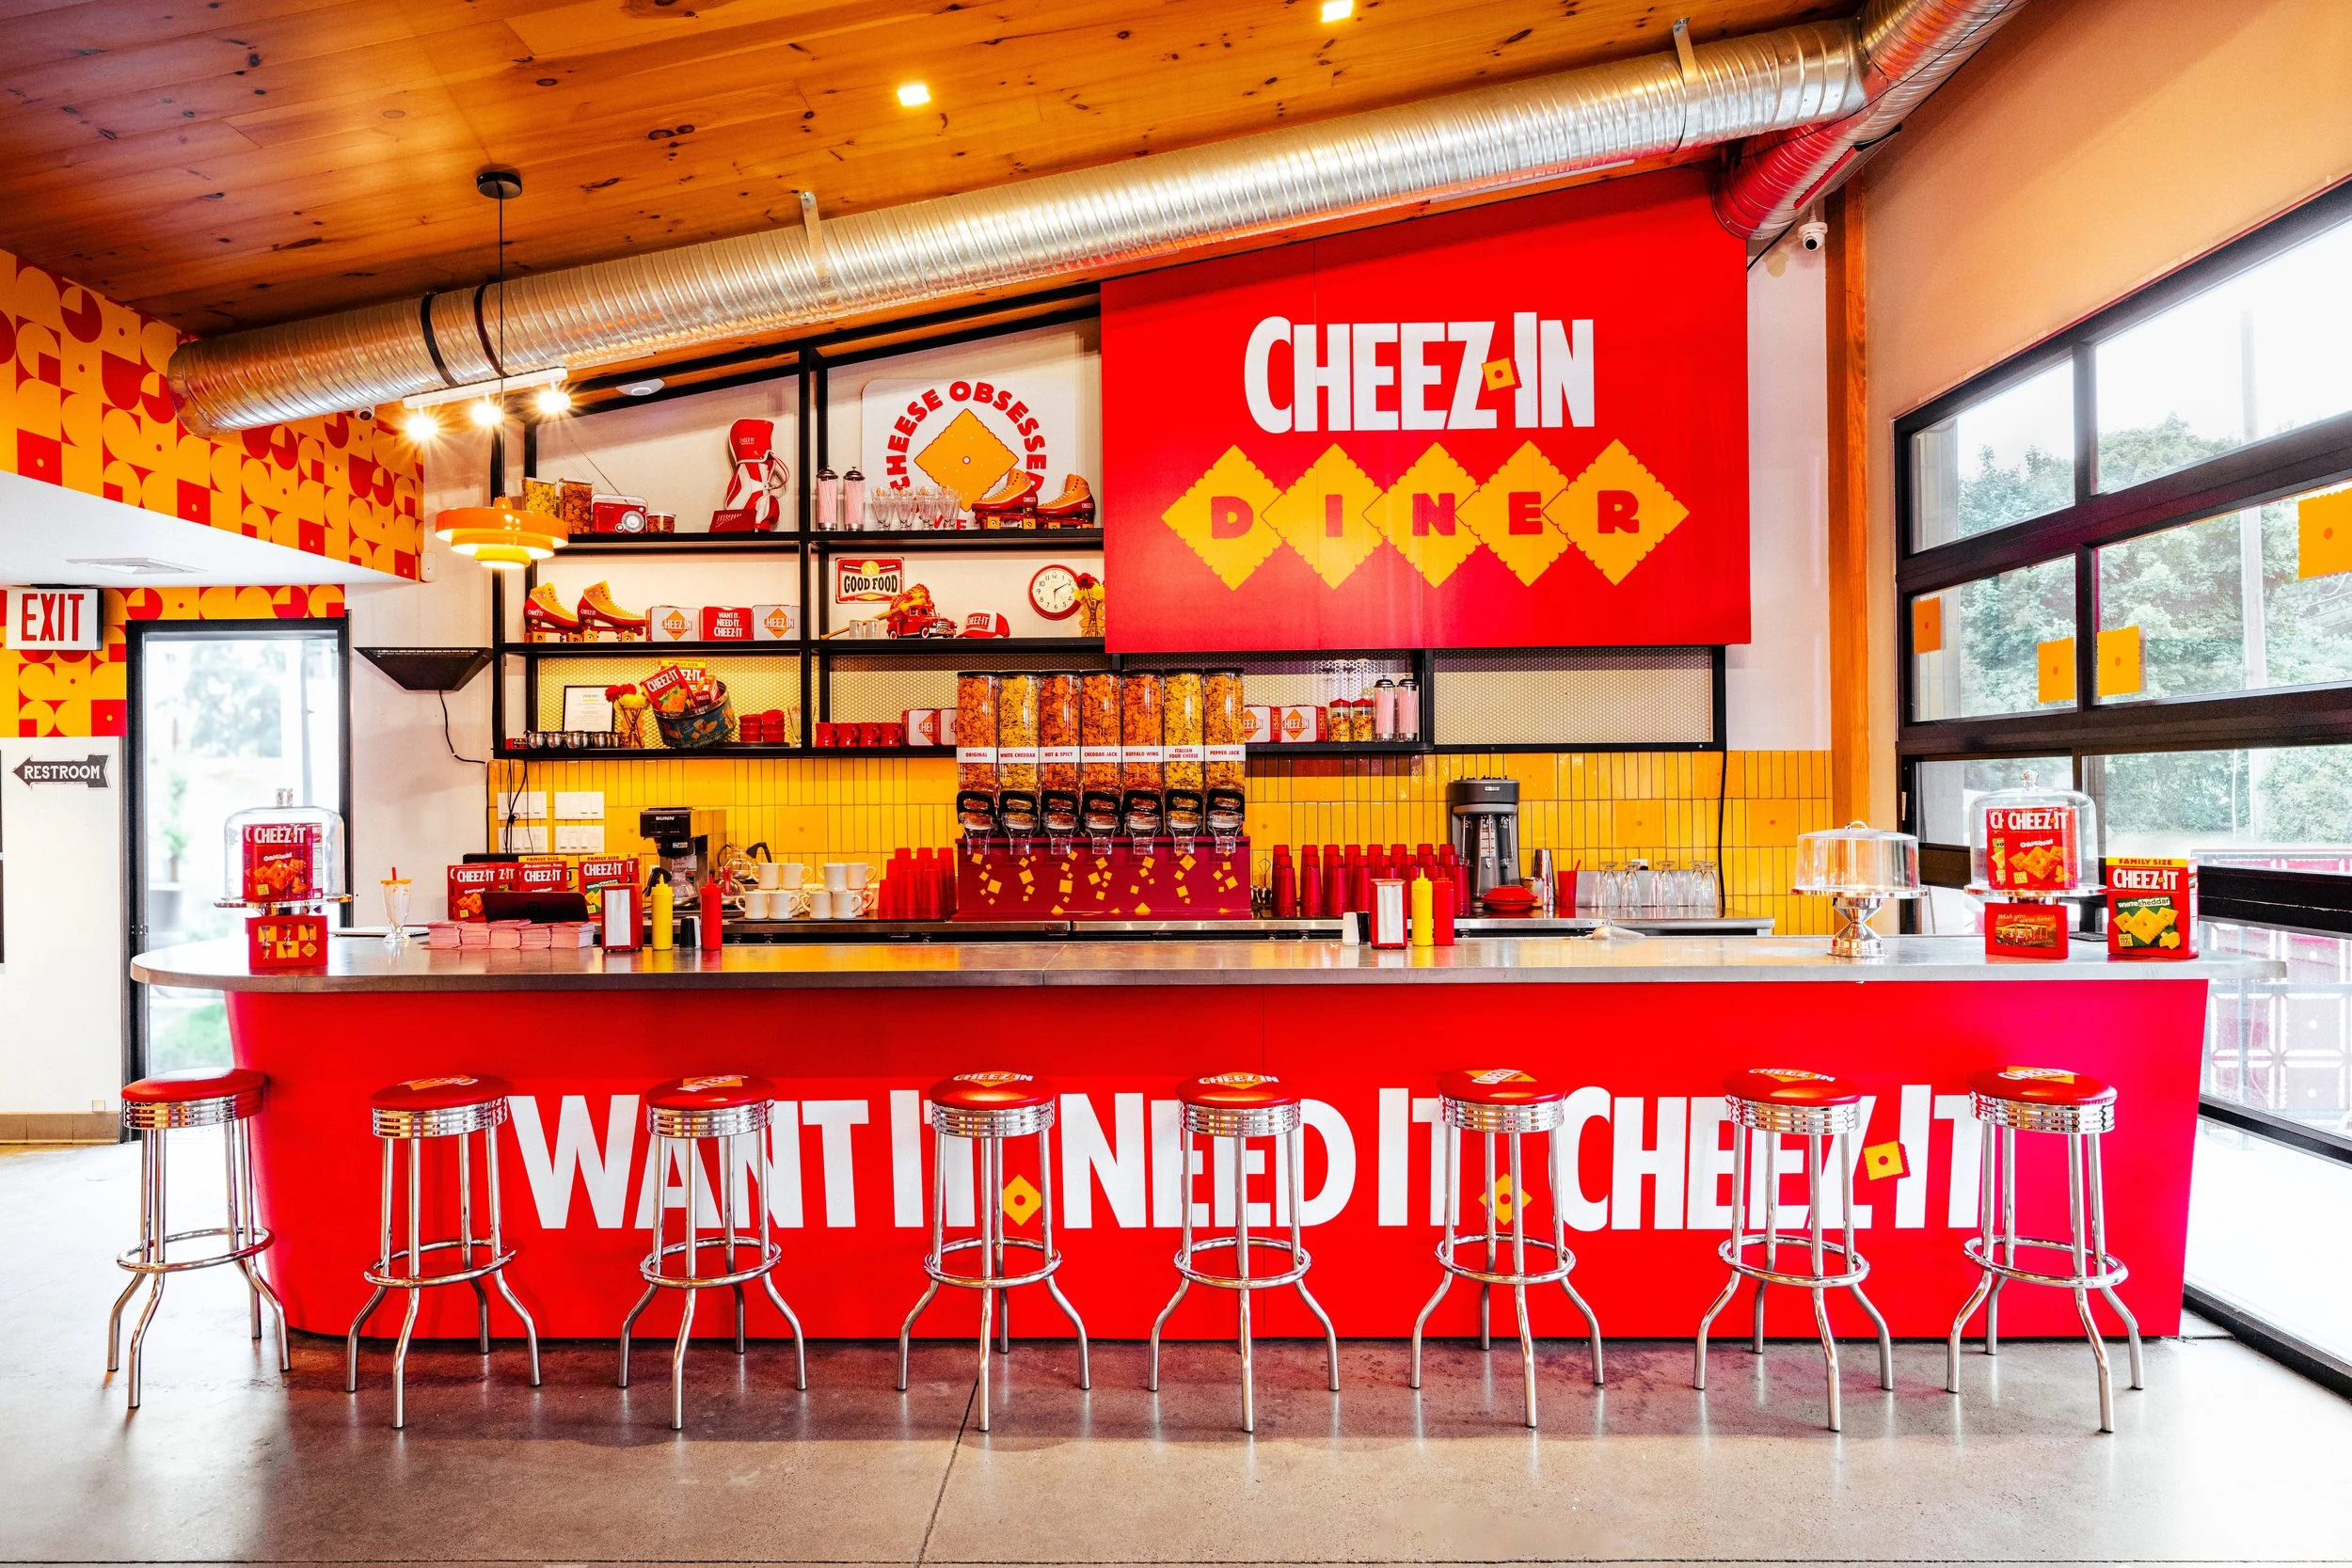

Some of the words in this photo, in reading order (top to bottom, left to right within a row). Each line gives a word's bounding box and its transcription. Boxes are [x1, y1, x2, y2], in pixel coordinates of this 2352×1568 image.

[885, 388, 944, 490] CHEESE
[1210, 489, 1641, 540] DINER
[844, 574, 870, 594] GOOD
[872, 574, 898, 593] FOOD
[21, 593, 84, 641] EXIT
[717, 618, 733, 627] NEED
[24, 765, 100, 779] RESTROOM
[507, 1094, 869, 1229] WANT
[890, 1090, 976, 1227] IT
[1060, 1092, 1357, 1229] NEED
[1378, 1088, 1461, 1227] IT
